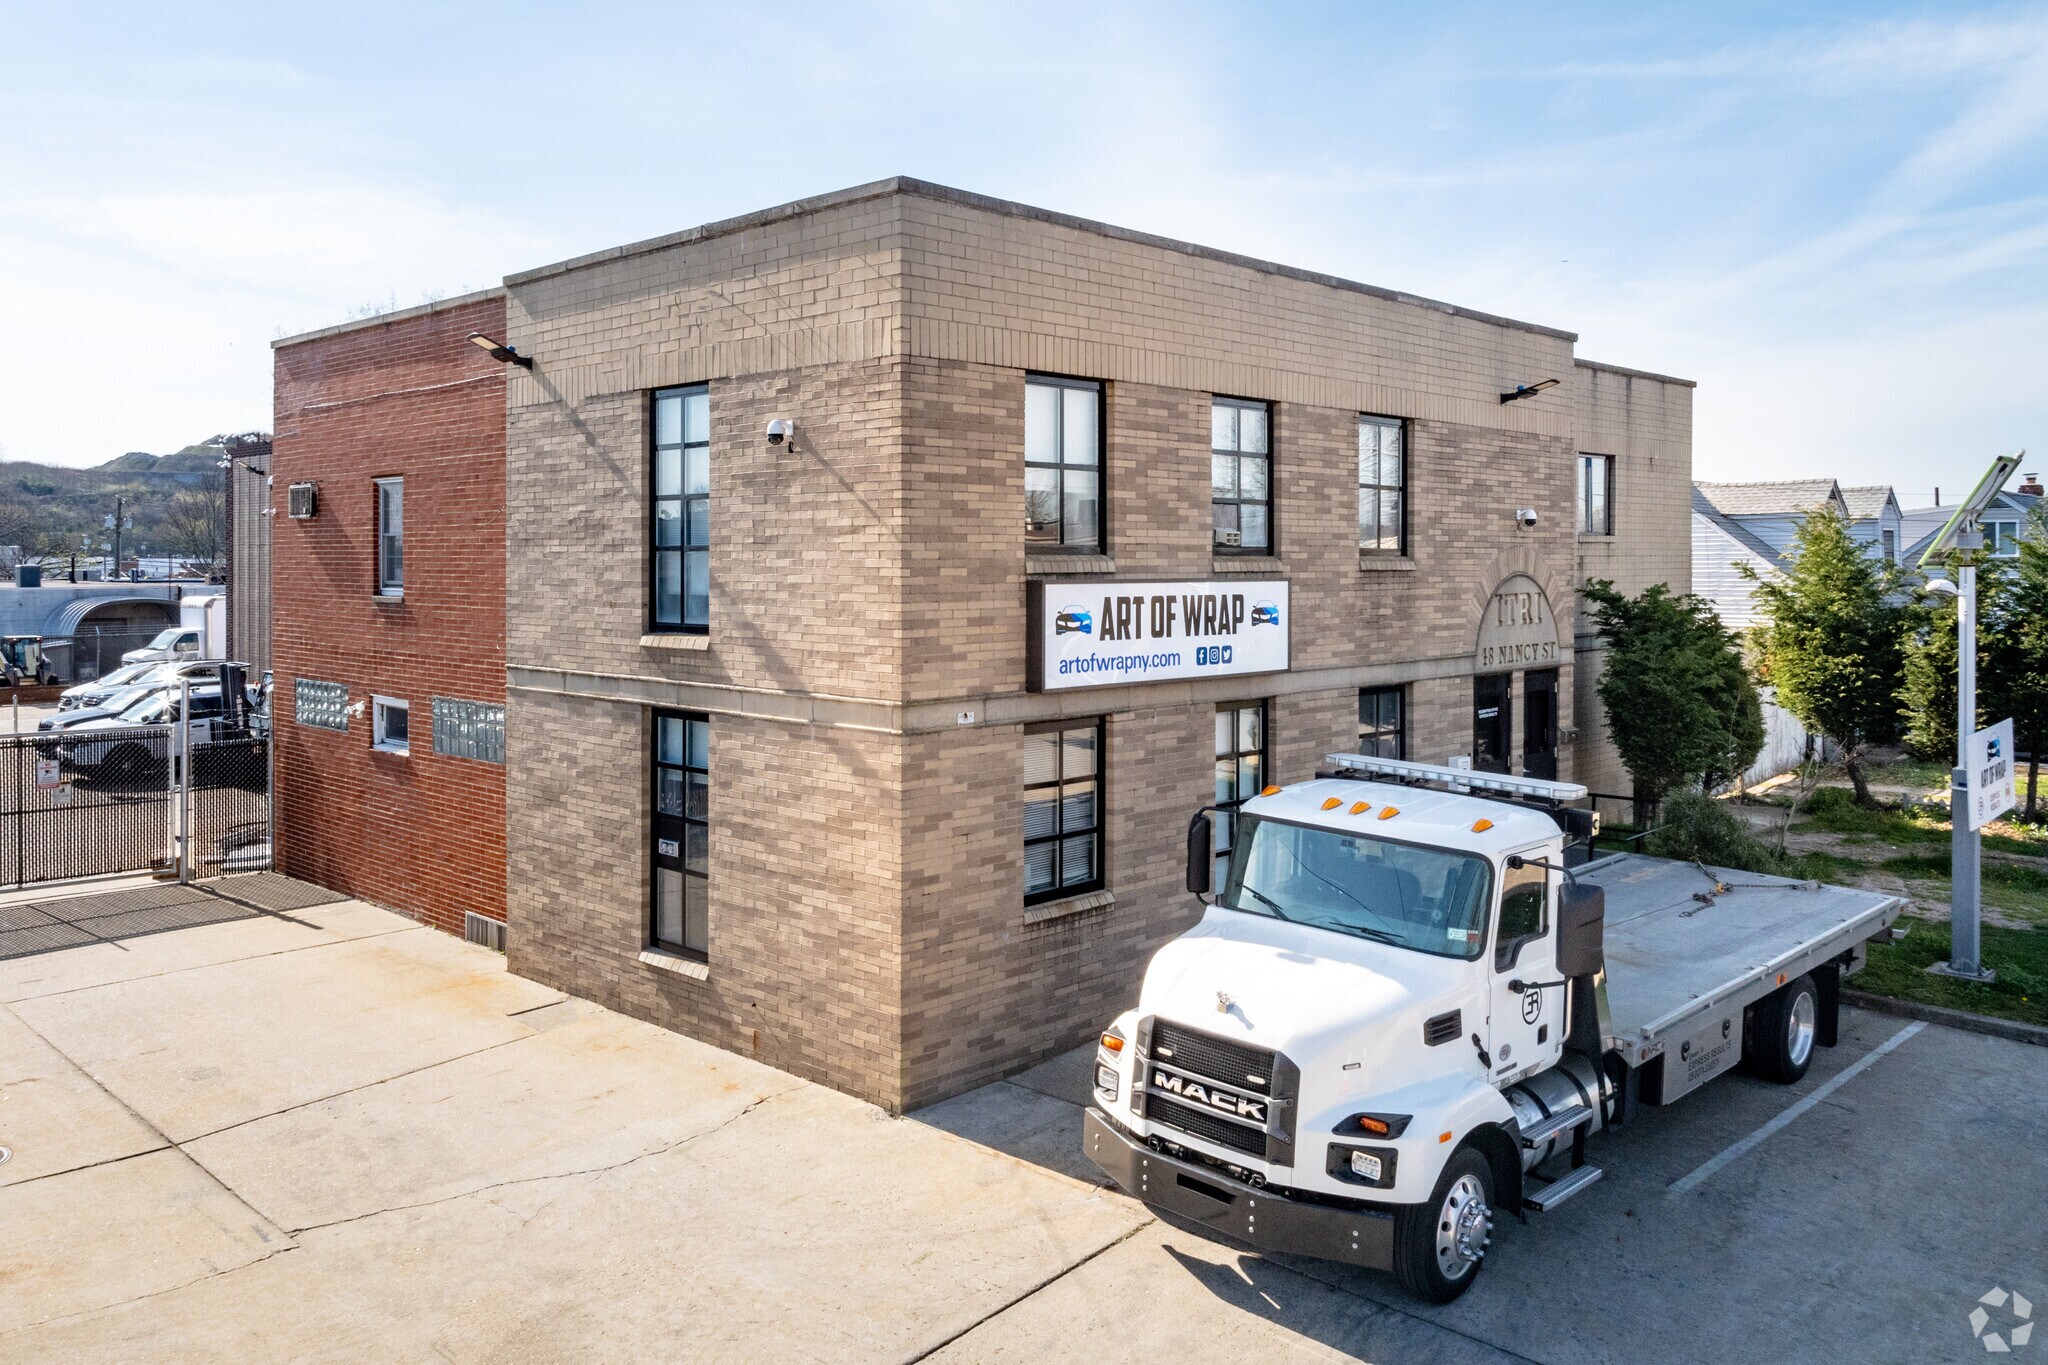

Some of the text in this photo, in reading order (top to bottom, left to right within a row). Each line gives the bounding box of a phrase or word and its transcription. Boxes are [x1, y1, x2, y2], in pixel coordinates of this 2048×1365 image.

[1099, 593, 1245, 641] ART OF WRAP
[1495, 592, 1542, 626] ITRI
[1059, 651, 1181, 675] artofwrapny.com
[1482, 646, 1495, 666] 48
[1499, 643, 1539, 665] NANCY
[1155, 1072, 1265, 1121] MACK
